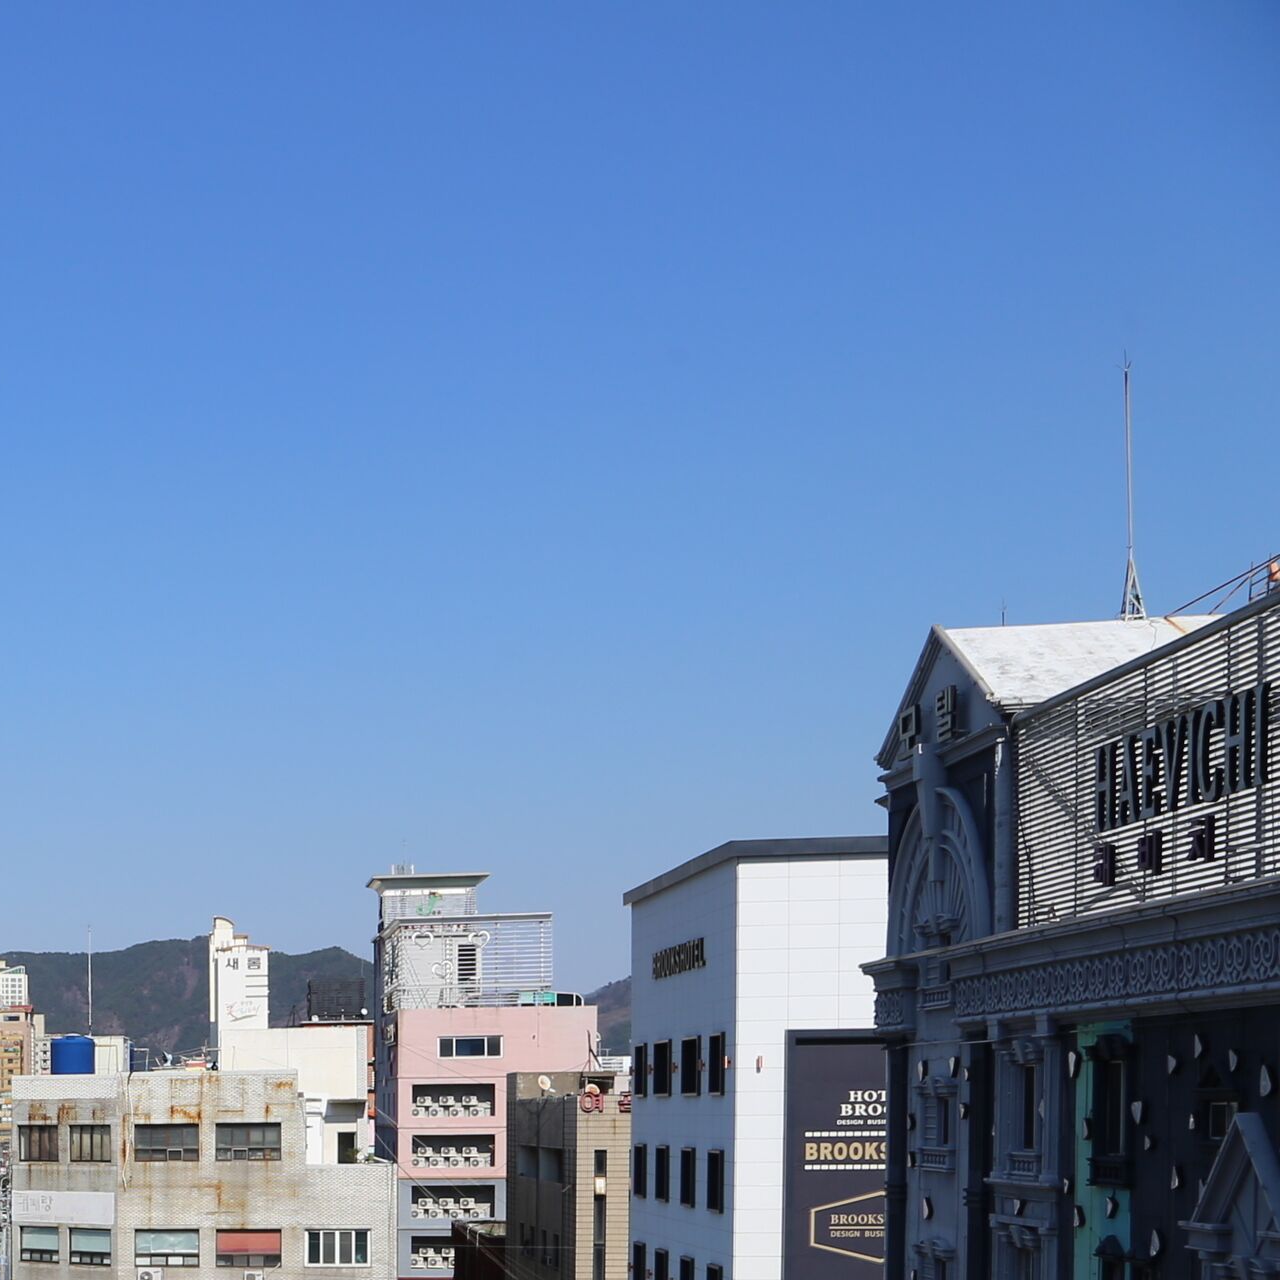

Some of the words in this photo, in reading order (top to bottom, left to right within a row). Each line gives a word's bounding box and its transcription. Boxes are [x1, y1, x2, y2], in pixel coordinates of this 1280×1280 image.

[1093, 682, 1271, 833] HAEVICHI
[1093, 815, 1216, 887] 해비치
[849, 1090, 886, 1102] HOT
[840, 1104, 886, 1116] BRO
[830, 1214, 884, 1225] BROOKS
